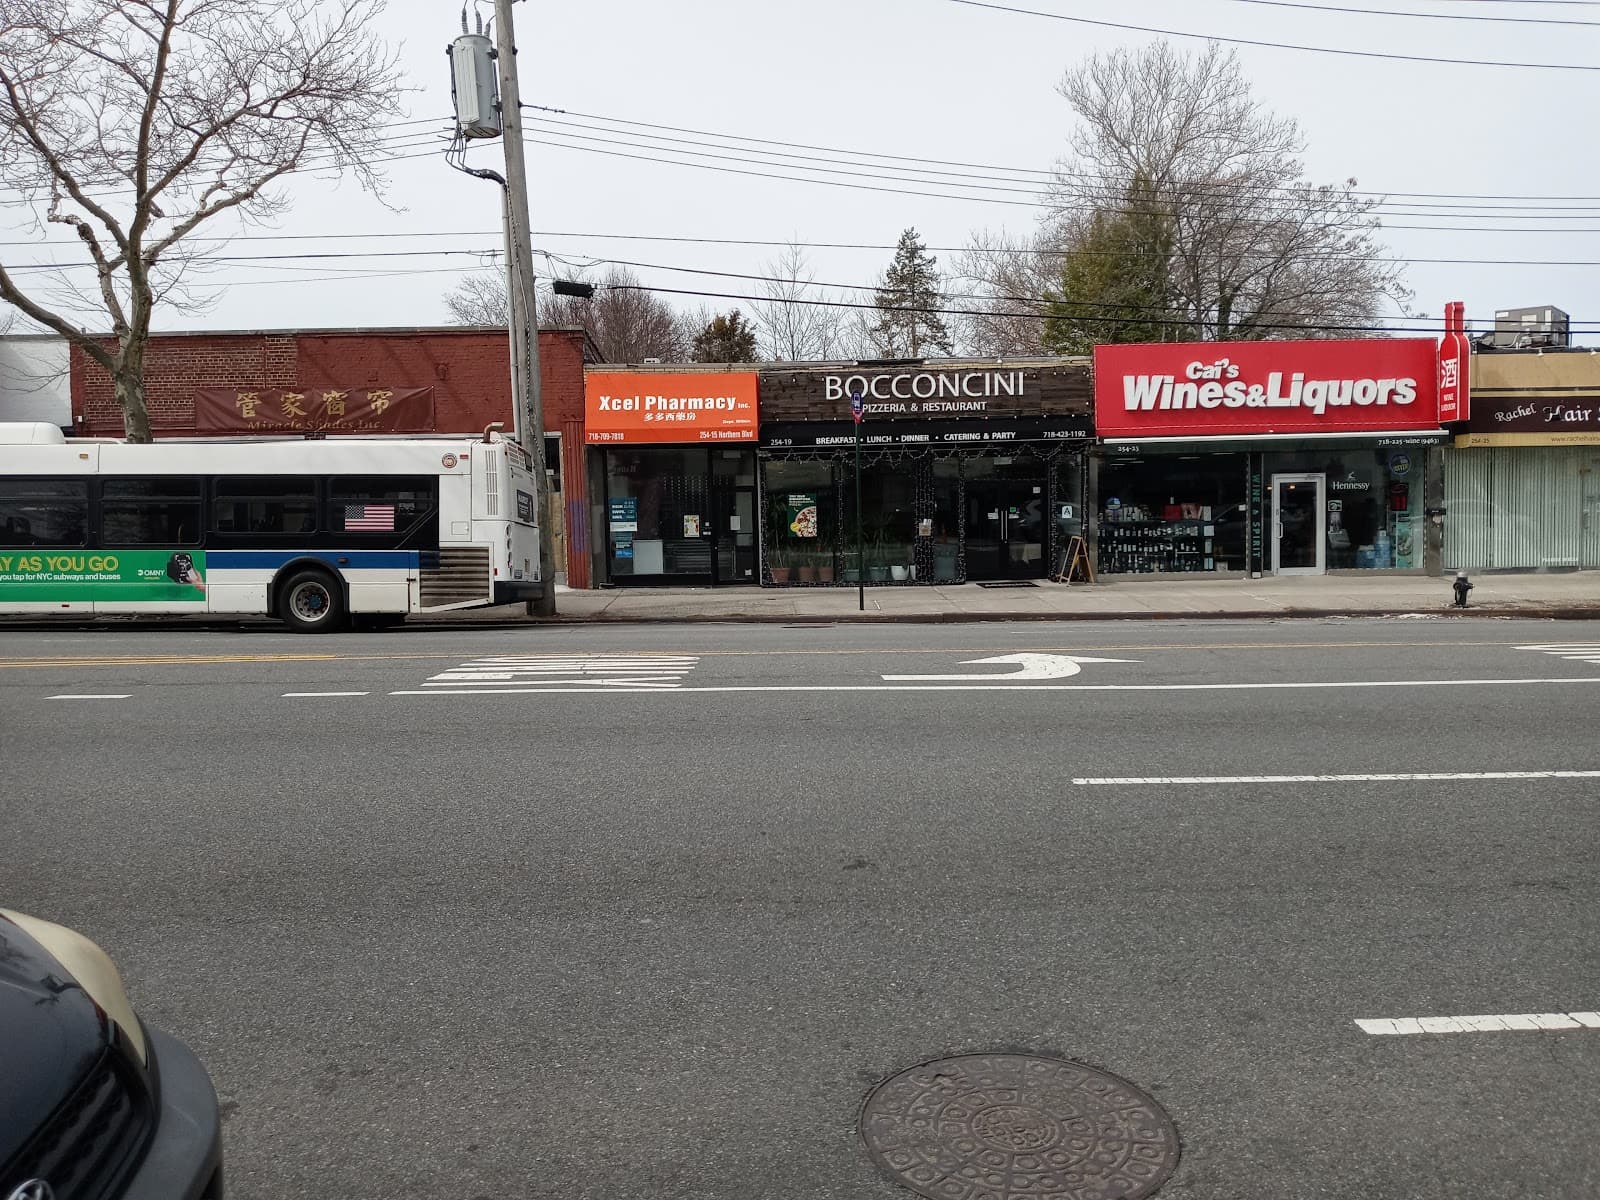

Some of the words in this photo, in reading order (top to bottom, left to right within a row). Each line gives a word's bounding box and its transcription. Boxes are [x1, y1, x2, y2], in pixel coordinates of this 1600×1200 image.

[1185, 358, 1239, 379] Cai's
[1441, 358, 1458, 389] 酒
[825, 371, 1024, 400] BOCCONCINI
[599, 395, 639, 411] Xcel
[645, 395, 736, 411] Pharmacy
[862, 403, 906, 413] PIZZERIA
[910, 403, 918, 412] &
[922, 401, 987, 412] RESTAURANT
[1494, 402, 1537, 422] Rachel
[1542, 404, 1592, 422] Hair
[248, 419, 302, 430] Miracle
[699, 431, 718, 439] 254-15
[718, 430, 741, 439] Northern
[741, 430, 753, 438] Blvd
[815, 436, 857, 445] BREAKFAST
[866, 435, 893, 443] LUNCH
[900, 434, 930, 442] DINNER
[943, 432, 981, 441] CATERING
[983, 432, 990, 440] &
[992, 431, 1017, 440] PARTY
[1042, 430, 1086, 438] 718-423-1192
[770, 438, 792, 446] 254-19
[1252, 474, 1261, 503] WINE
[1332, 481, 1370, 491] Hennessy
[1252, 521, 1261, 558] SPIRIT
[0, 556, 14, 572] Y
[18, 556, 42, 572] AS
[46, 555, 86, 572] YOU
[88, 555, 119, 572] GO
[12, 573, 25, 582] tap
[53, 573, 84, 581] subways
[144, 569, 165, 577] OMNY
